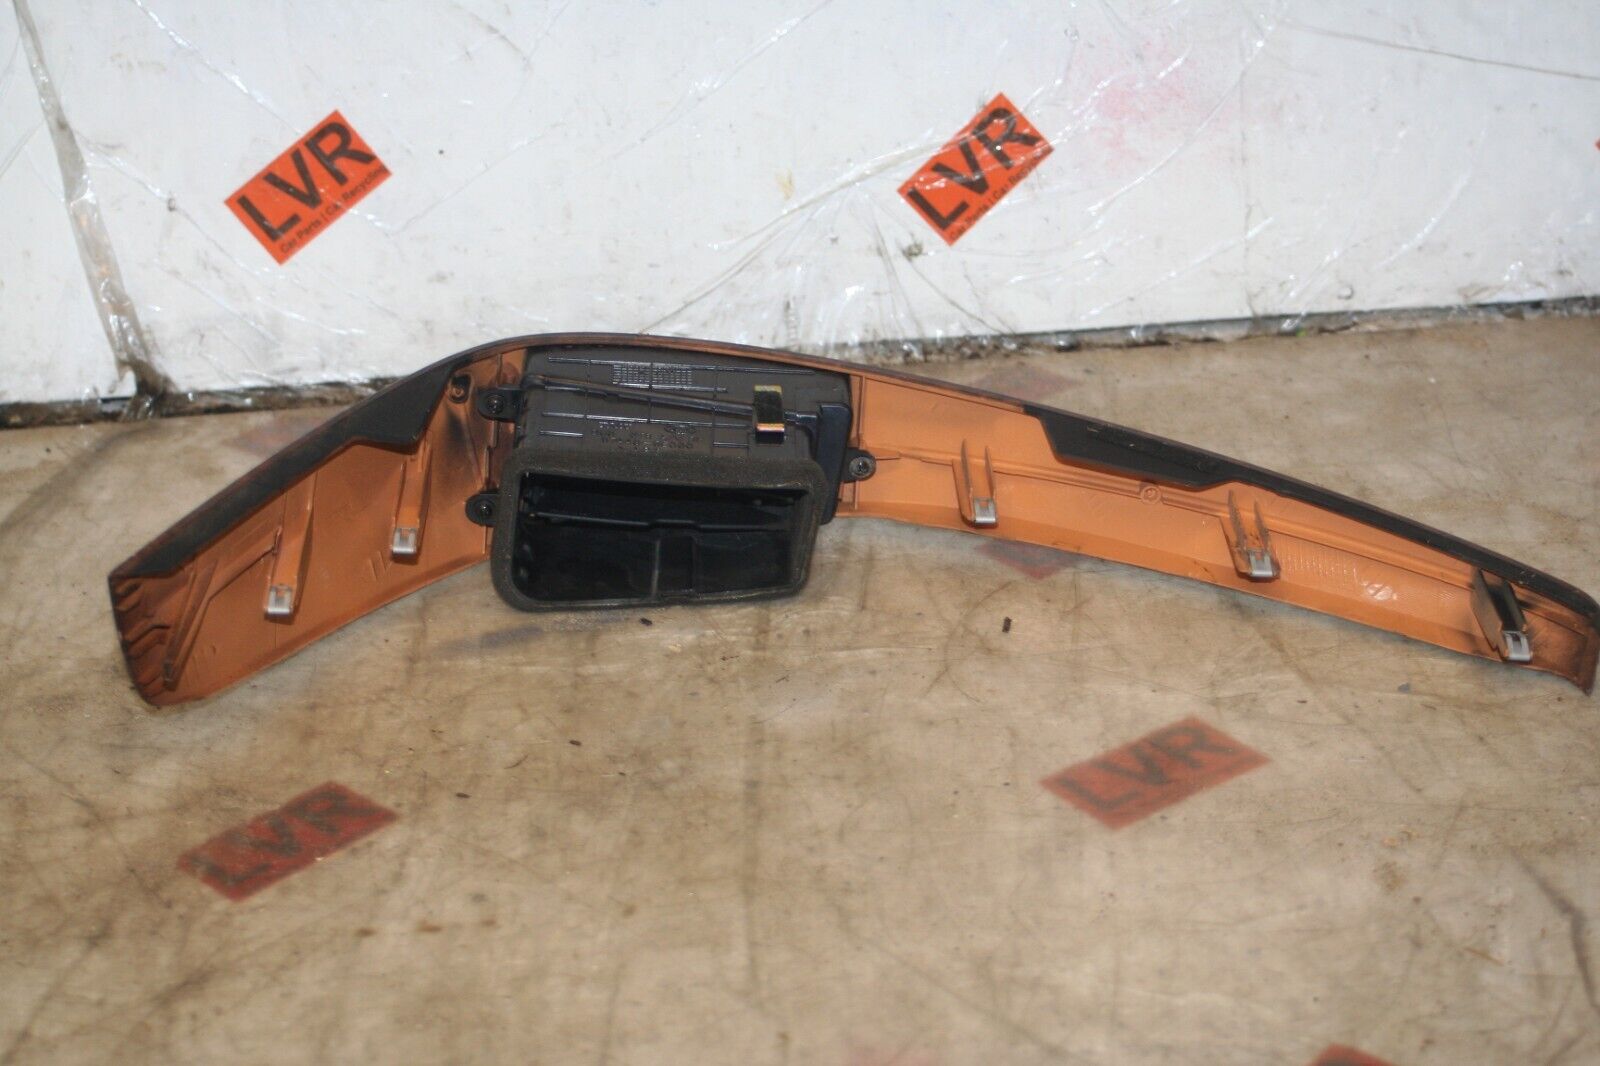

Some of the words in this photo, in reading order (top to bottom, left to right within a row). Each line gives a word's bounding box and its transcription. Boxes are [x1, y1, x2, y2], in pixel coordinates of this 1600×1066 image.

[237, 122, 376, 242] LVR
[324, 199, 343, 217] Ca
[907, 107, 1040, 230] LVR
[1058, 726, 1238, 812] LVR
[189, 790, 387, 885] LVR
